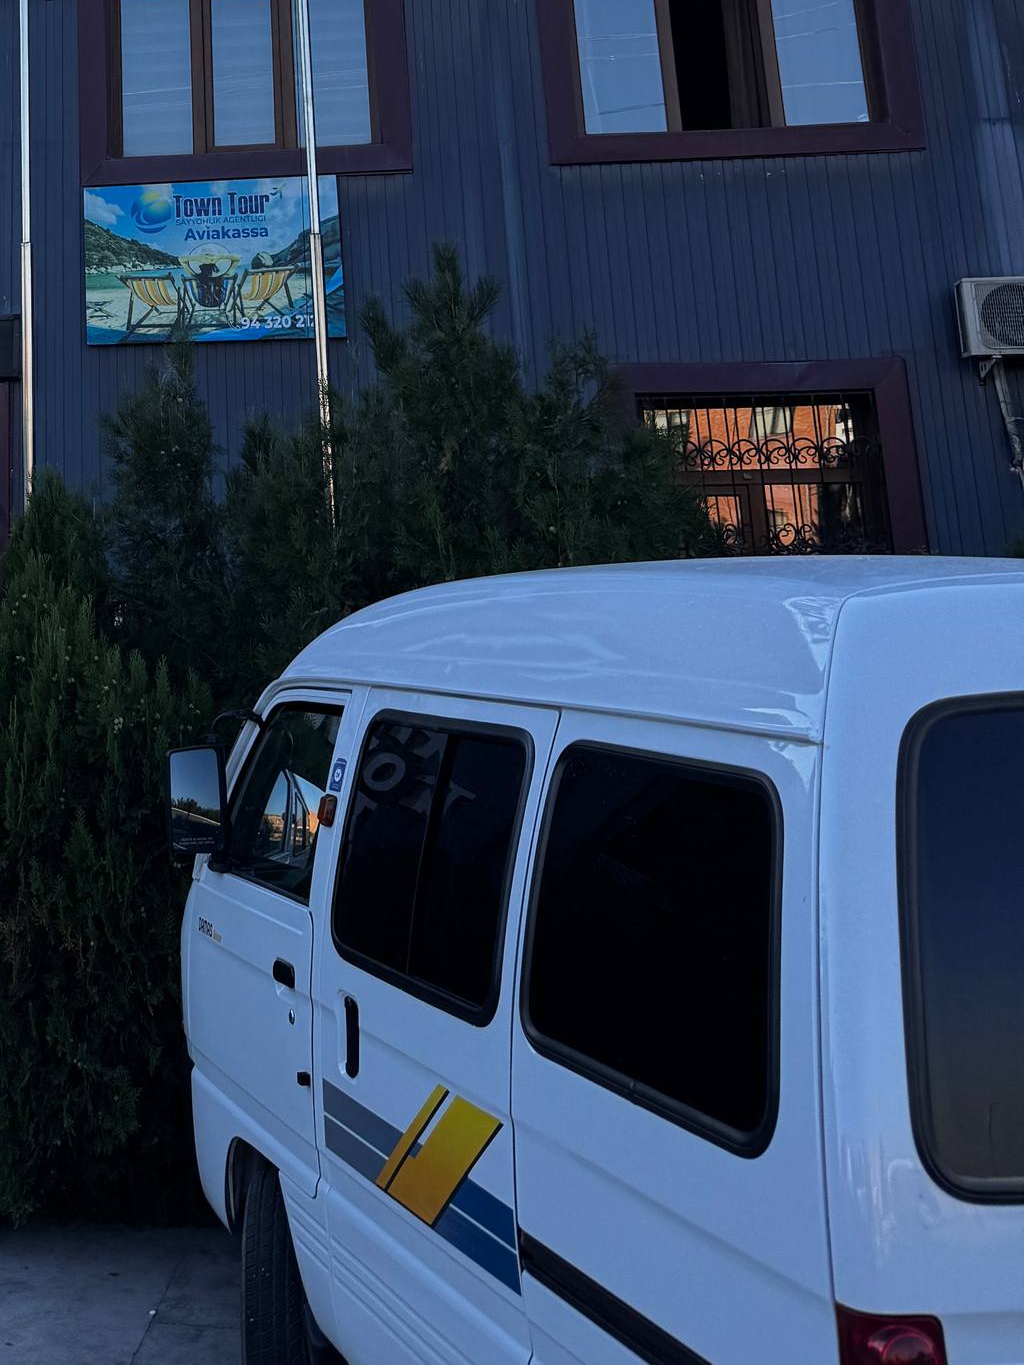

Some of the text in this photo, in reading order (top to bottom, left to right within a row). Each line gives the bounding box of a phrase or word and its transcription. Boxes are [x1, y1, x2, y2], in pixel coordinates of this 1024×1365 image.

[173, 192, 270, 218] Town Tour
[175, 215, 266, 226] SAYYOHLIK AGENTLIGI
[184, 226, 269, 241] Aviakassa
[240, 315, 260, 329] 94
[264, 315, 292, 329] 320
